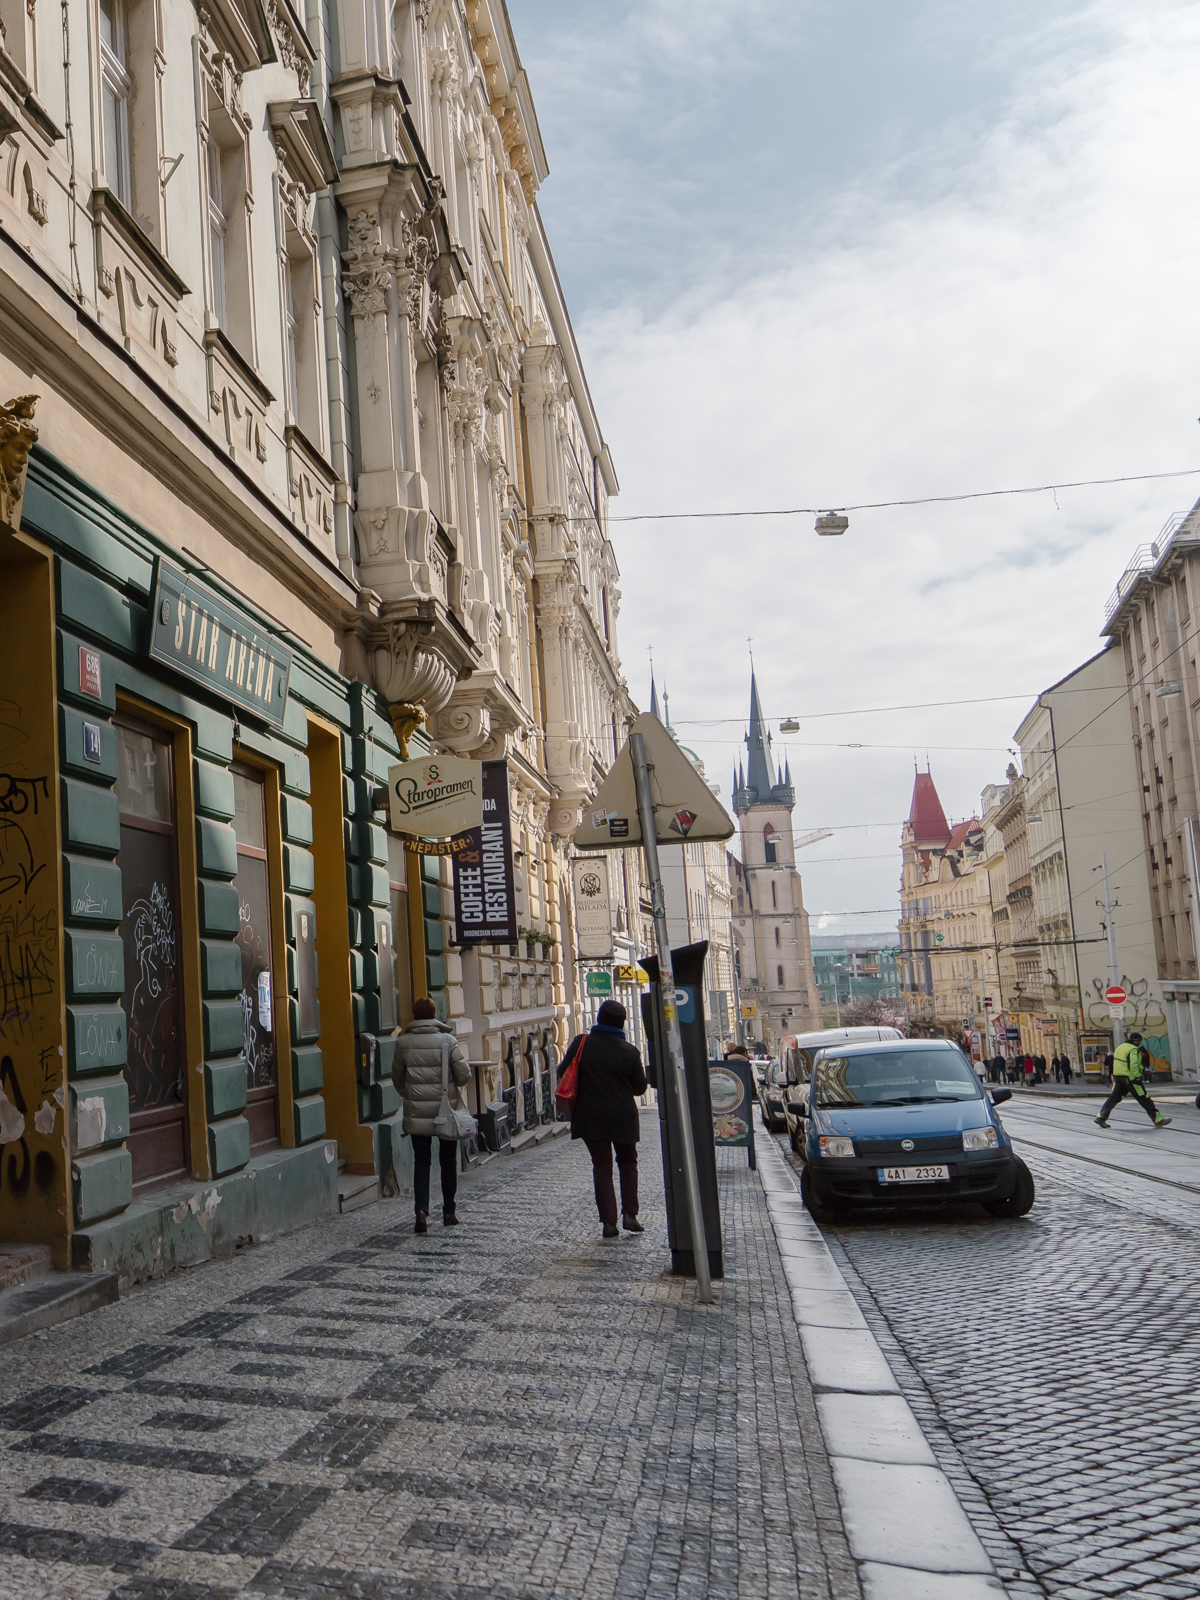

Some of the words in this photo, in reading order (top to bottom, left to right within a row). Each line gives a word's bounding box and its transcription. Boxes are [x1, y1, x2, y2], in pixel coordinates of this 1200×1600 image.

[174, 593, 220, 672] STAR
[225, 629, 275, 705] ARÉNA
[91, 733, 99, 754] 14
[395, 777, 476, 815] Staropramen
[409, 838, 468, 854] NEPASTER
[458, 849, 480, 863] &
[481, 821, 509, 922] RESTAURANT
[459, 867, 484, 923] COFFEE
[463, 929, 490, 937] INDONESIAN
[491, 928, 509, 937] CUISINE
[915, 1168, 944, 1179] 2332
